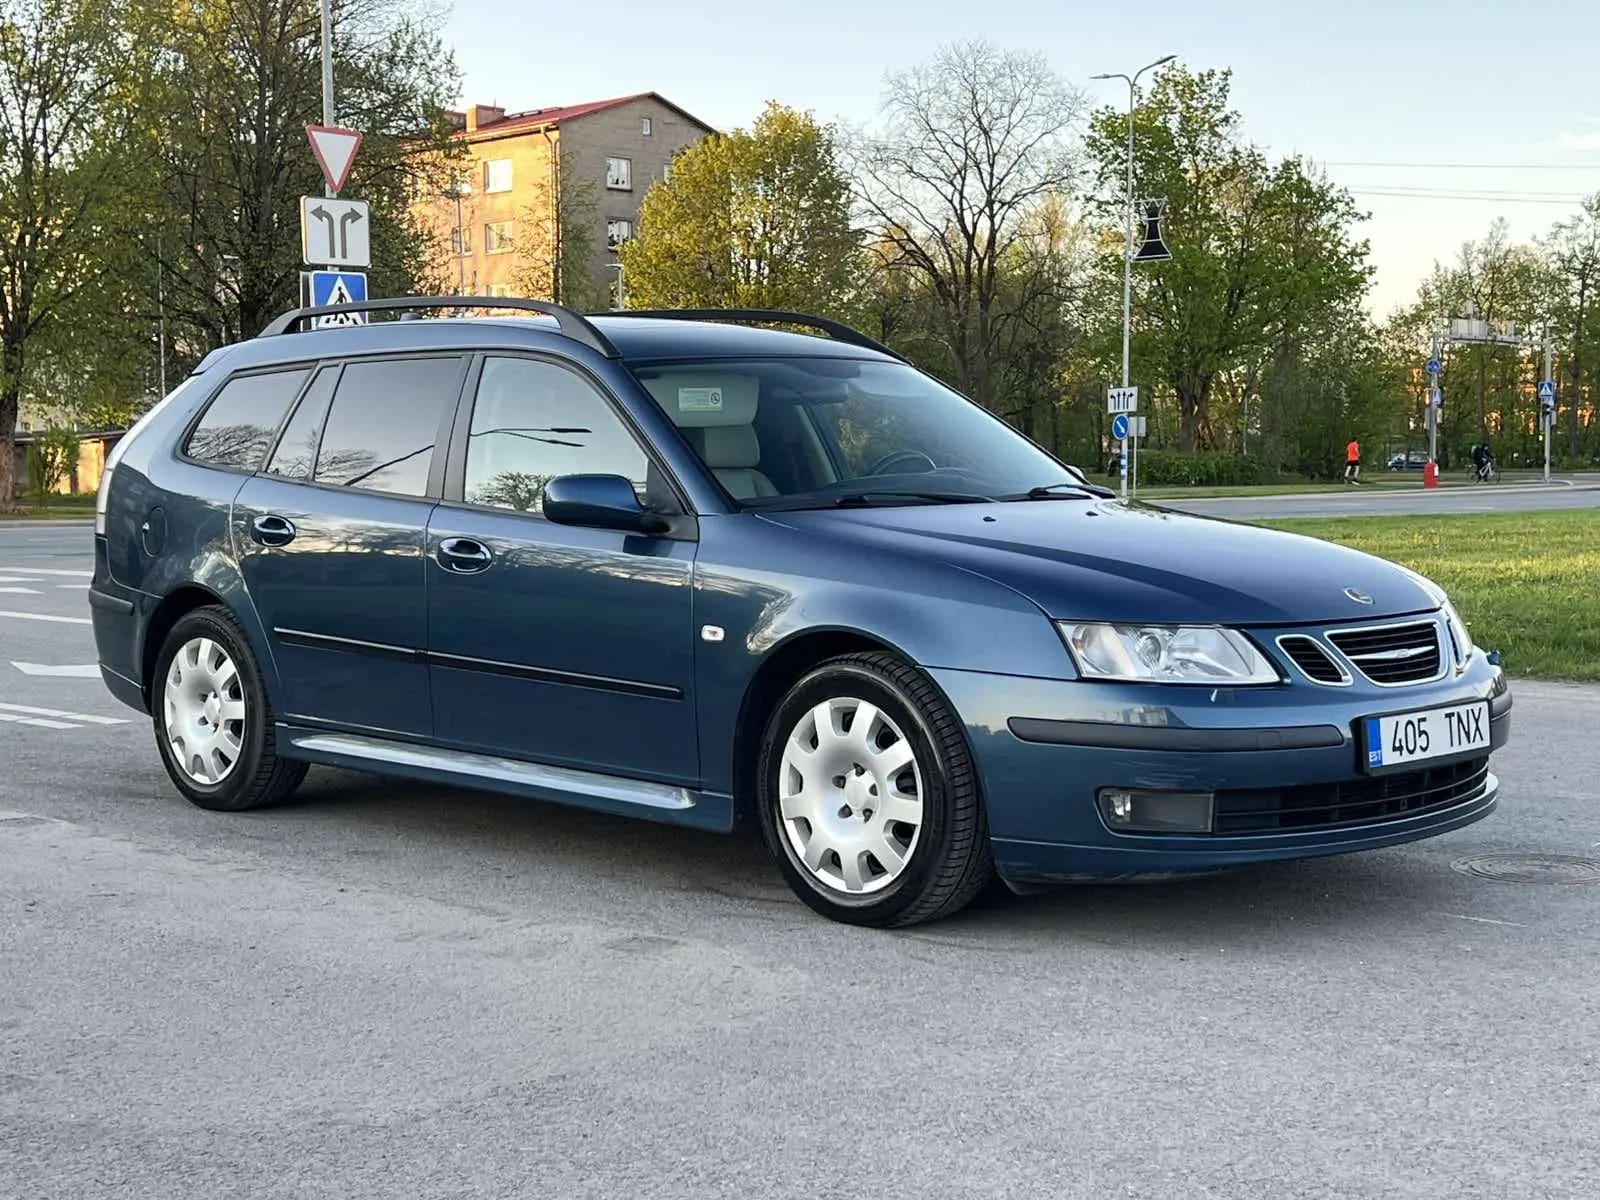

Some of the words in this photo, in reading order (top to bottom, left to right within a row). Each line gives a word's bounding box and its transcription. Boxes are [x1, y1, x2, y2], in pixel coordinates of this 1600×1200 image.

[1392, 717, 1430, 756] 405
[1444, 707, 1484, 747] TNX
[1369, 751, 1382, 761] EST
